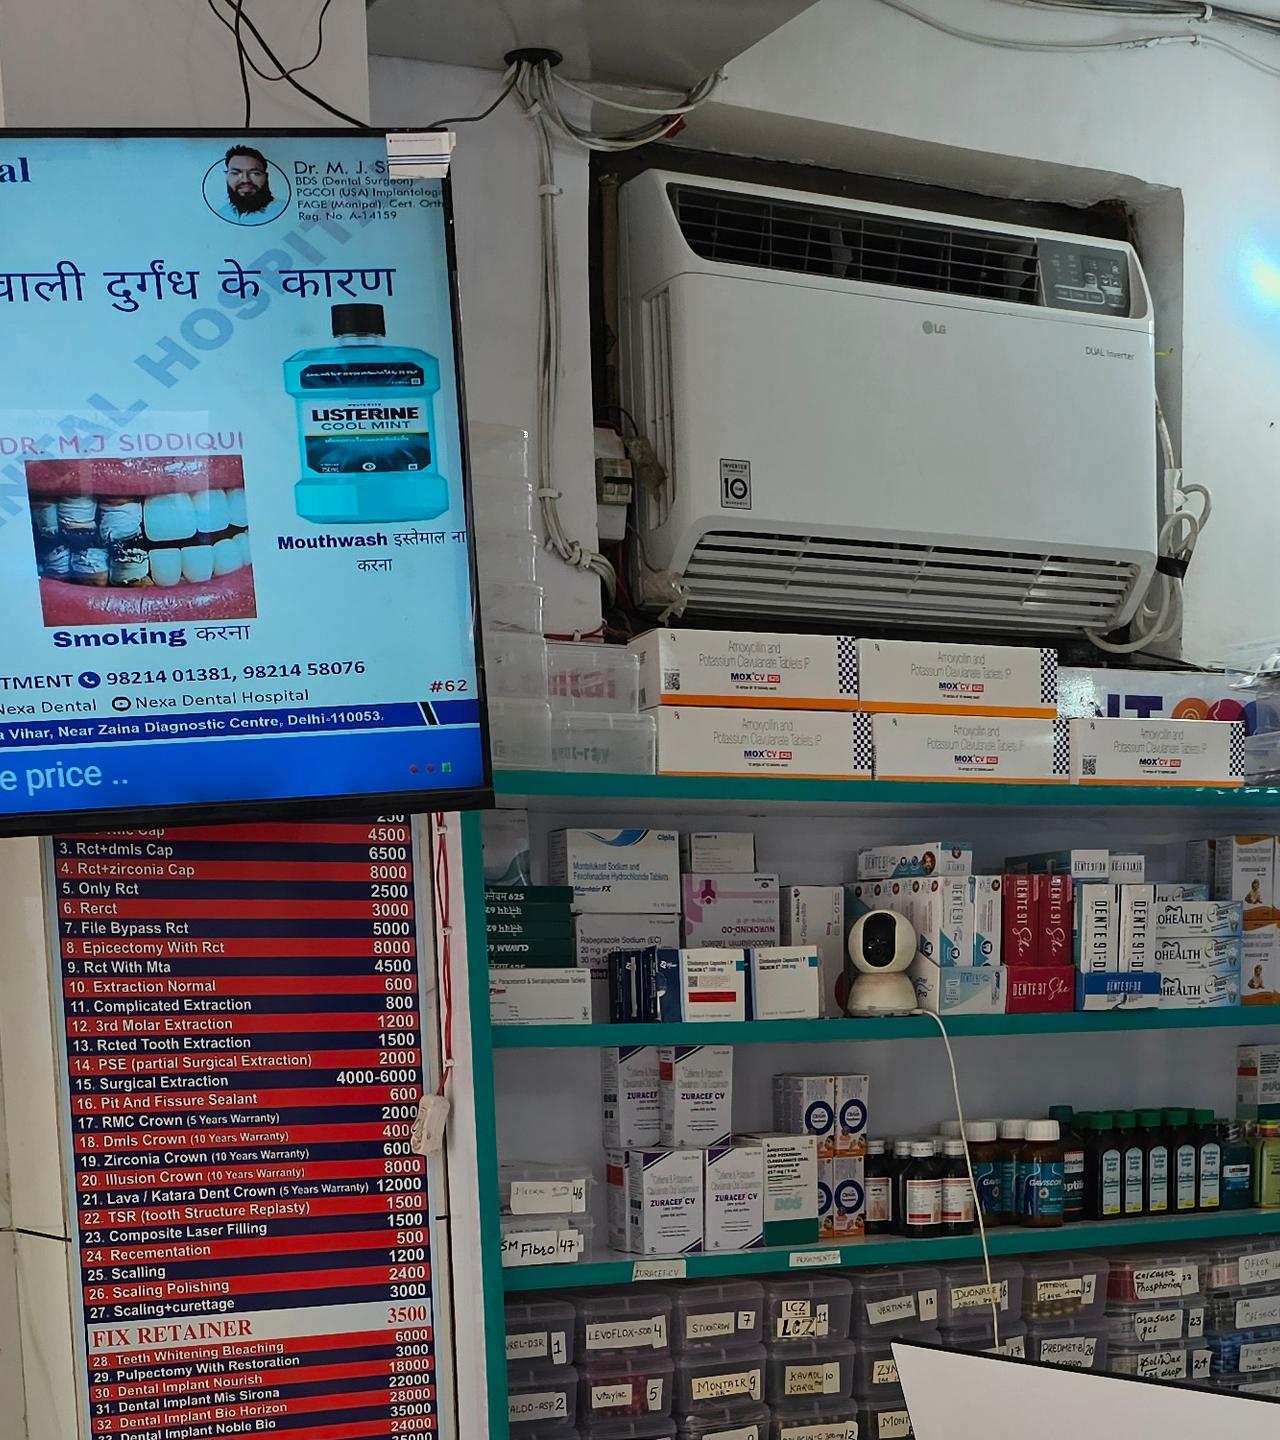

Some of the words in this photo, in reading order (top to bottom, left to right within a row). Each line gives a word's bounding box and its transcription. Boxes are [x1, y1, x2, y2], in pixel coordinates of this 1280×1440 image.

[339, 188, 369, 198] (USA)
[104, 260, 199, 311] दुर्गंध
[218, 259, 261, 300] के
[279, 266, 396, 300] कारण
[933, 322, 947, 336] LG
[1085, 345, 1105, 357] DUAL
[1106, 349, 1135, 361] Inverter
[310, 406, 419, 423] LISTERINE
[320, 421, 362, 432] COOL
[369, 419, 411, 431] MINT
[0, 435, 45, 456] DR.
[58, 433, 106, 453] M.J
[119, 431, 244, 452] SIDDIQUI
[278, 532, 388, 551] Mouthwash
[393, 525, 448, 548] इस्तेमाल
[53, 625, 187, 649] Smoking
[195, 622, 252, 646] करना
[106, 667, 169, 686] 98214
[172, 666, 238, 686] 01381,
[242, 663, 302, 681] 98214
[306, 660, 366, 677] 58076
[429, 678, 468, 693] #62
[9, 727, 53, 743] Vihar,
[58, 724, 94, 738] Near
[98, 721, 140, 736] Zaina
[144, 716, 224, 735] Diagnostic
[229, 714, 284, 729] Centre,
[26, 761, 103, 794] price
[62, 883, 75, 895] 5.
[79, 882, 112, 897] Only
[115, 883, 139, 895] Rct
[370, 884, 408, 898] 2500
[69, 981, 89, 993] 10.
[93, 980, 164, 993] Extraction
[167, 979, 216, 992] Normal
[384, 978, 412, 991] 600
[78, 1116, 99, 1129] 17.
[102, 1115, 135, 1128] RMC
[139, 1114, 183, 1127] Crown
[186, 1114, 196, 1127] (5
[198, 1113, 227, 1125] Years
[230, 1112, 280, 1126] Warranty)
[397, 1231, 424, 1244] 500
[110, 1244, 211, 1261] Recementation
[92, 1328, 131, 1348] FIX
[138, 1319, 253, 1344] RETAINER
[387, 1306, 427, 1324] 3500
[395, 1329, 428, 1342] 6000
[93, 1355, 112, 1367] 28.
[116, 1352, 151, 1366] Teeth
[154, 1346, 218, 1363] Whitening
[222, 1341, 284, 1357] Bleaching
